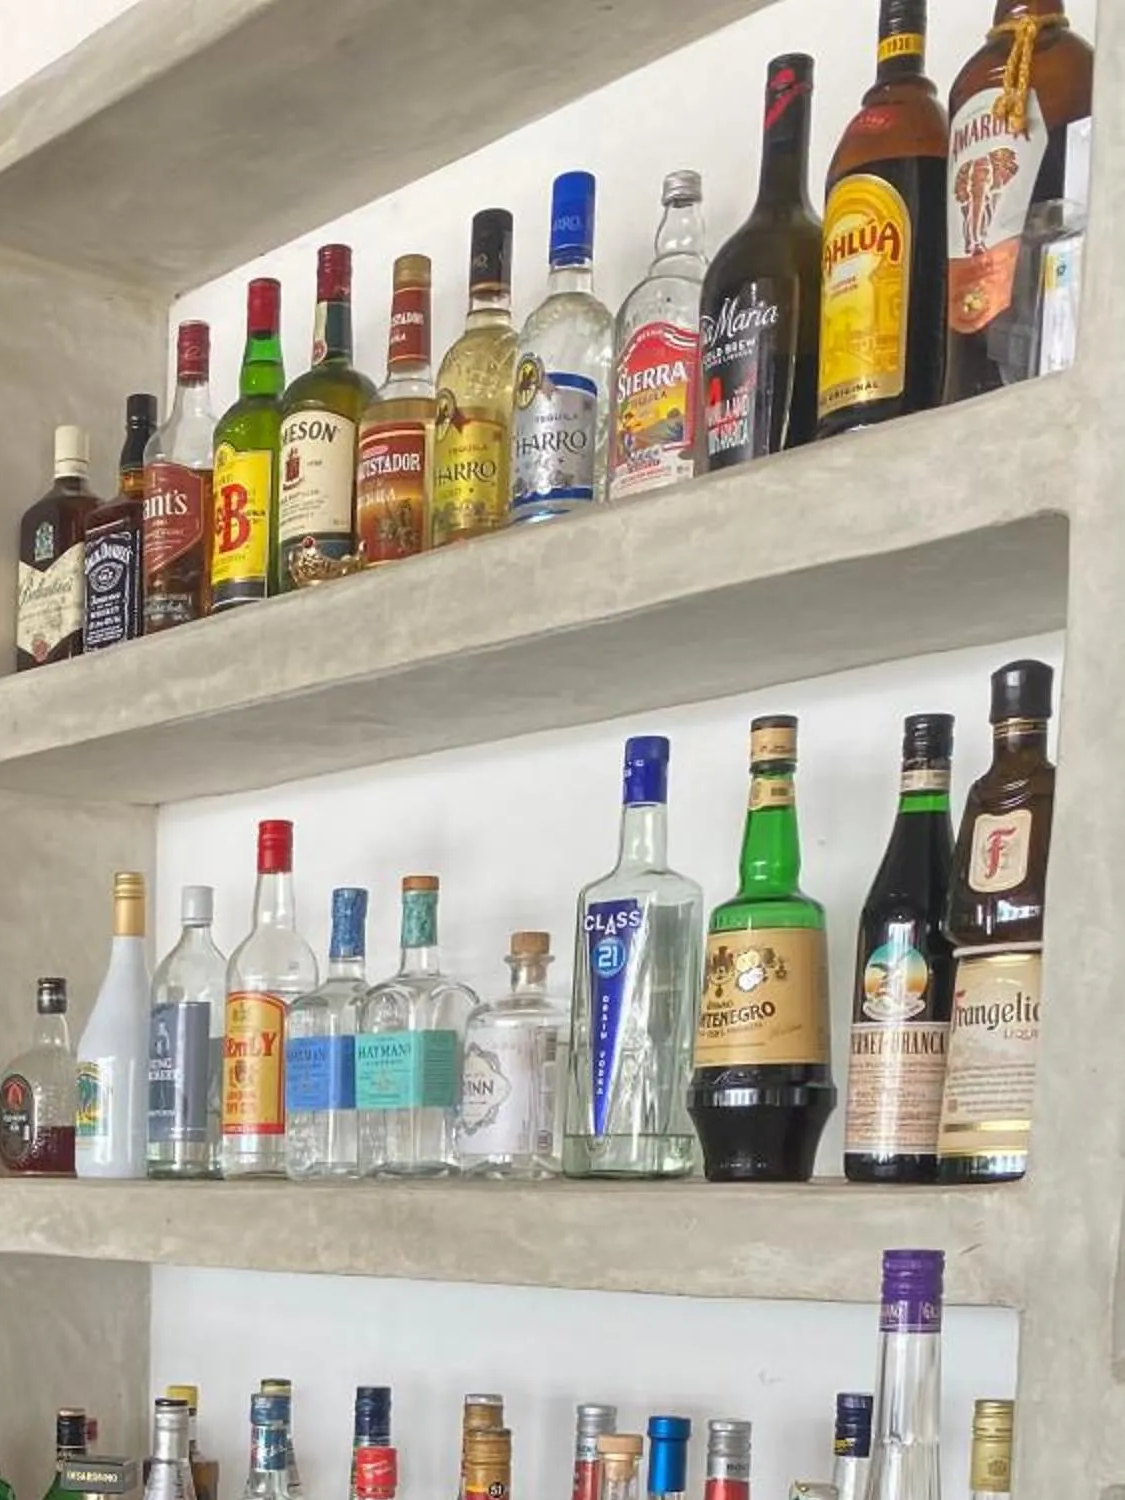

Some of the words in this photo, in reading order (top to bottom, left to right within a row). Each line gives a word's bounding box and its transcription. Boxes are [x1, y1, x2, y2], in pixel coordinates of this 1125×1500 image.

[719, 296, 779, 338] Maria
[618, 361, 689, 403] SIERRA
[143, 488, 188, 520] ant's
[583, 910, 642, 936] CLASS
[597, 946, 619, 969] 21
[489, 1484, 503, 1496] 51
